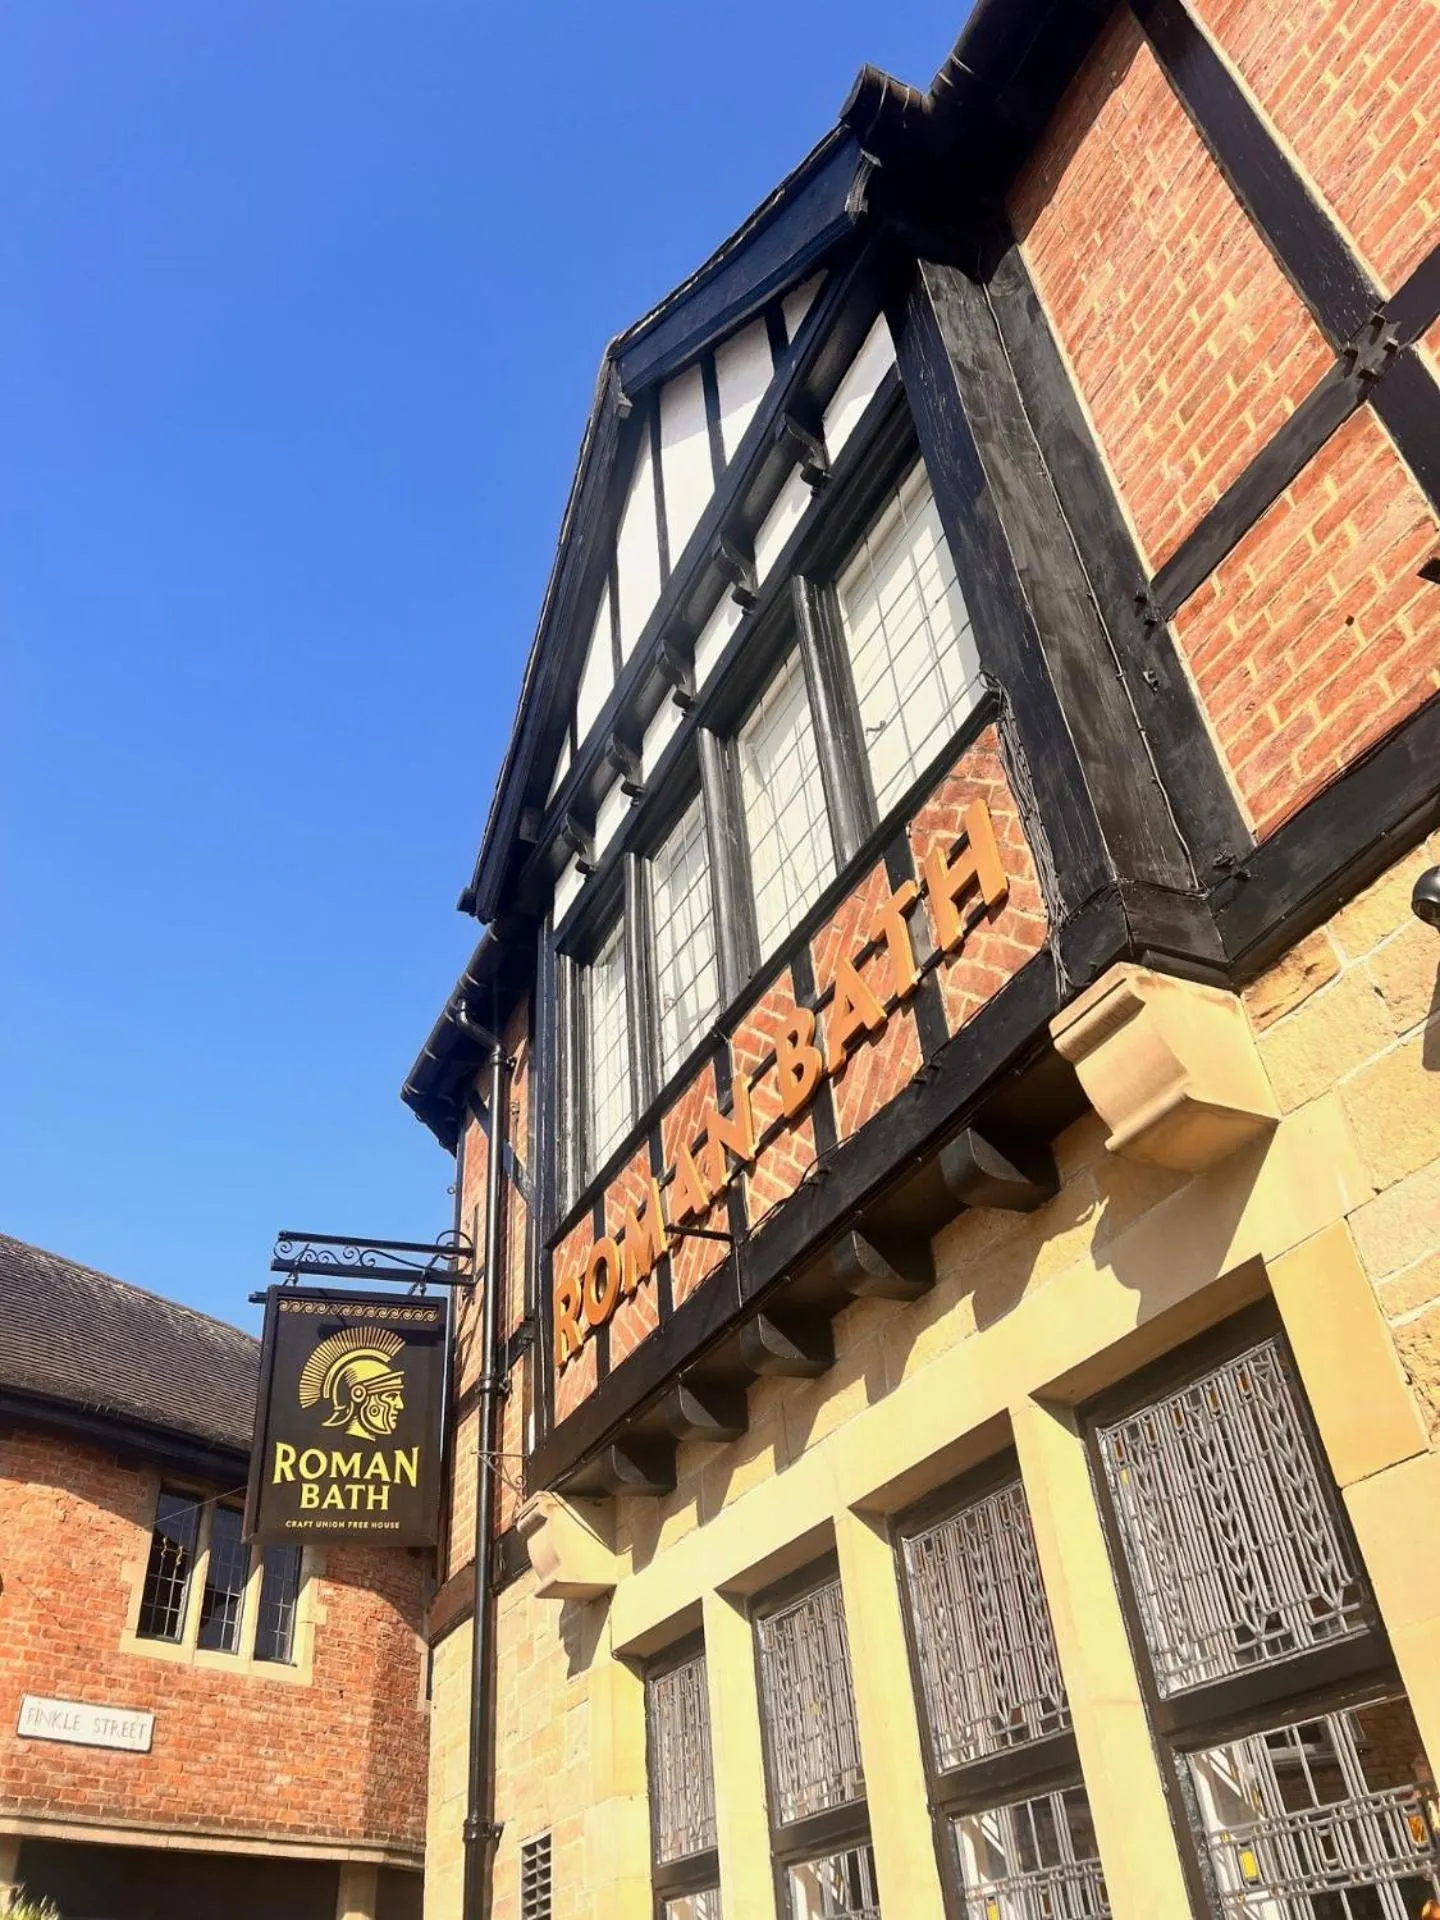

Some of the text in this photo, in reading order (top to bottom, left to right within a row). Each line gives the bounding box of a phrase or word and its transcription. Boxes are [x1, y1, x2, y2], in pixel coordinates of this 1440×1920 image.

[553, 798, 1008, 1366] ROMAN BATH
[272, 1442, 420, 1487] ROMAN
[299, 1482, 389, 1511] BATH
[285, 1519, 400, 1529] CRAFT UNION FREE HOUSE
[26, 1707, 147, 1740] FINKLE STREET
